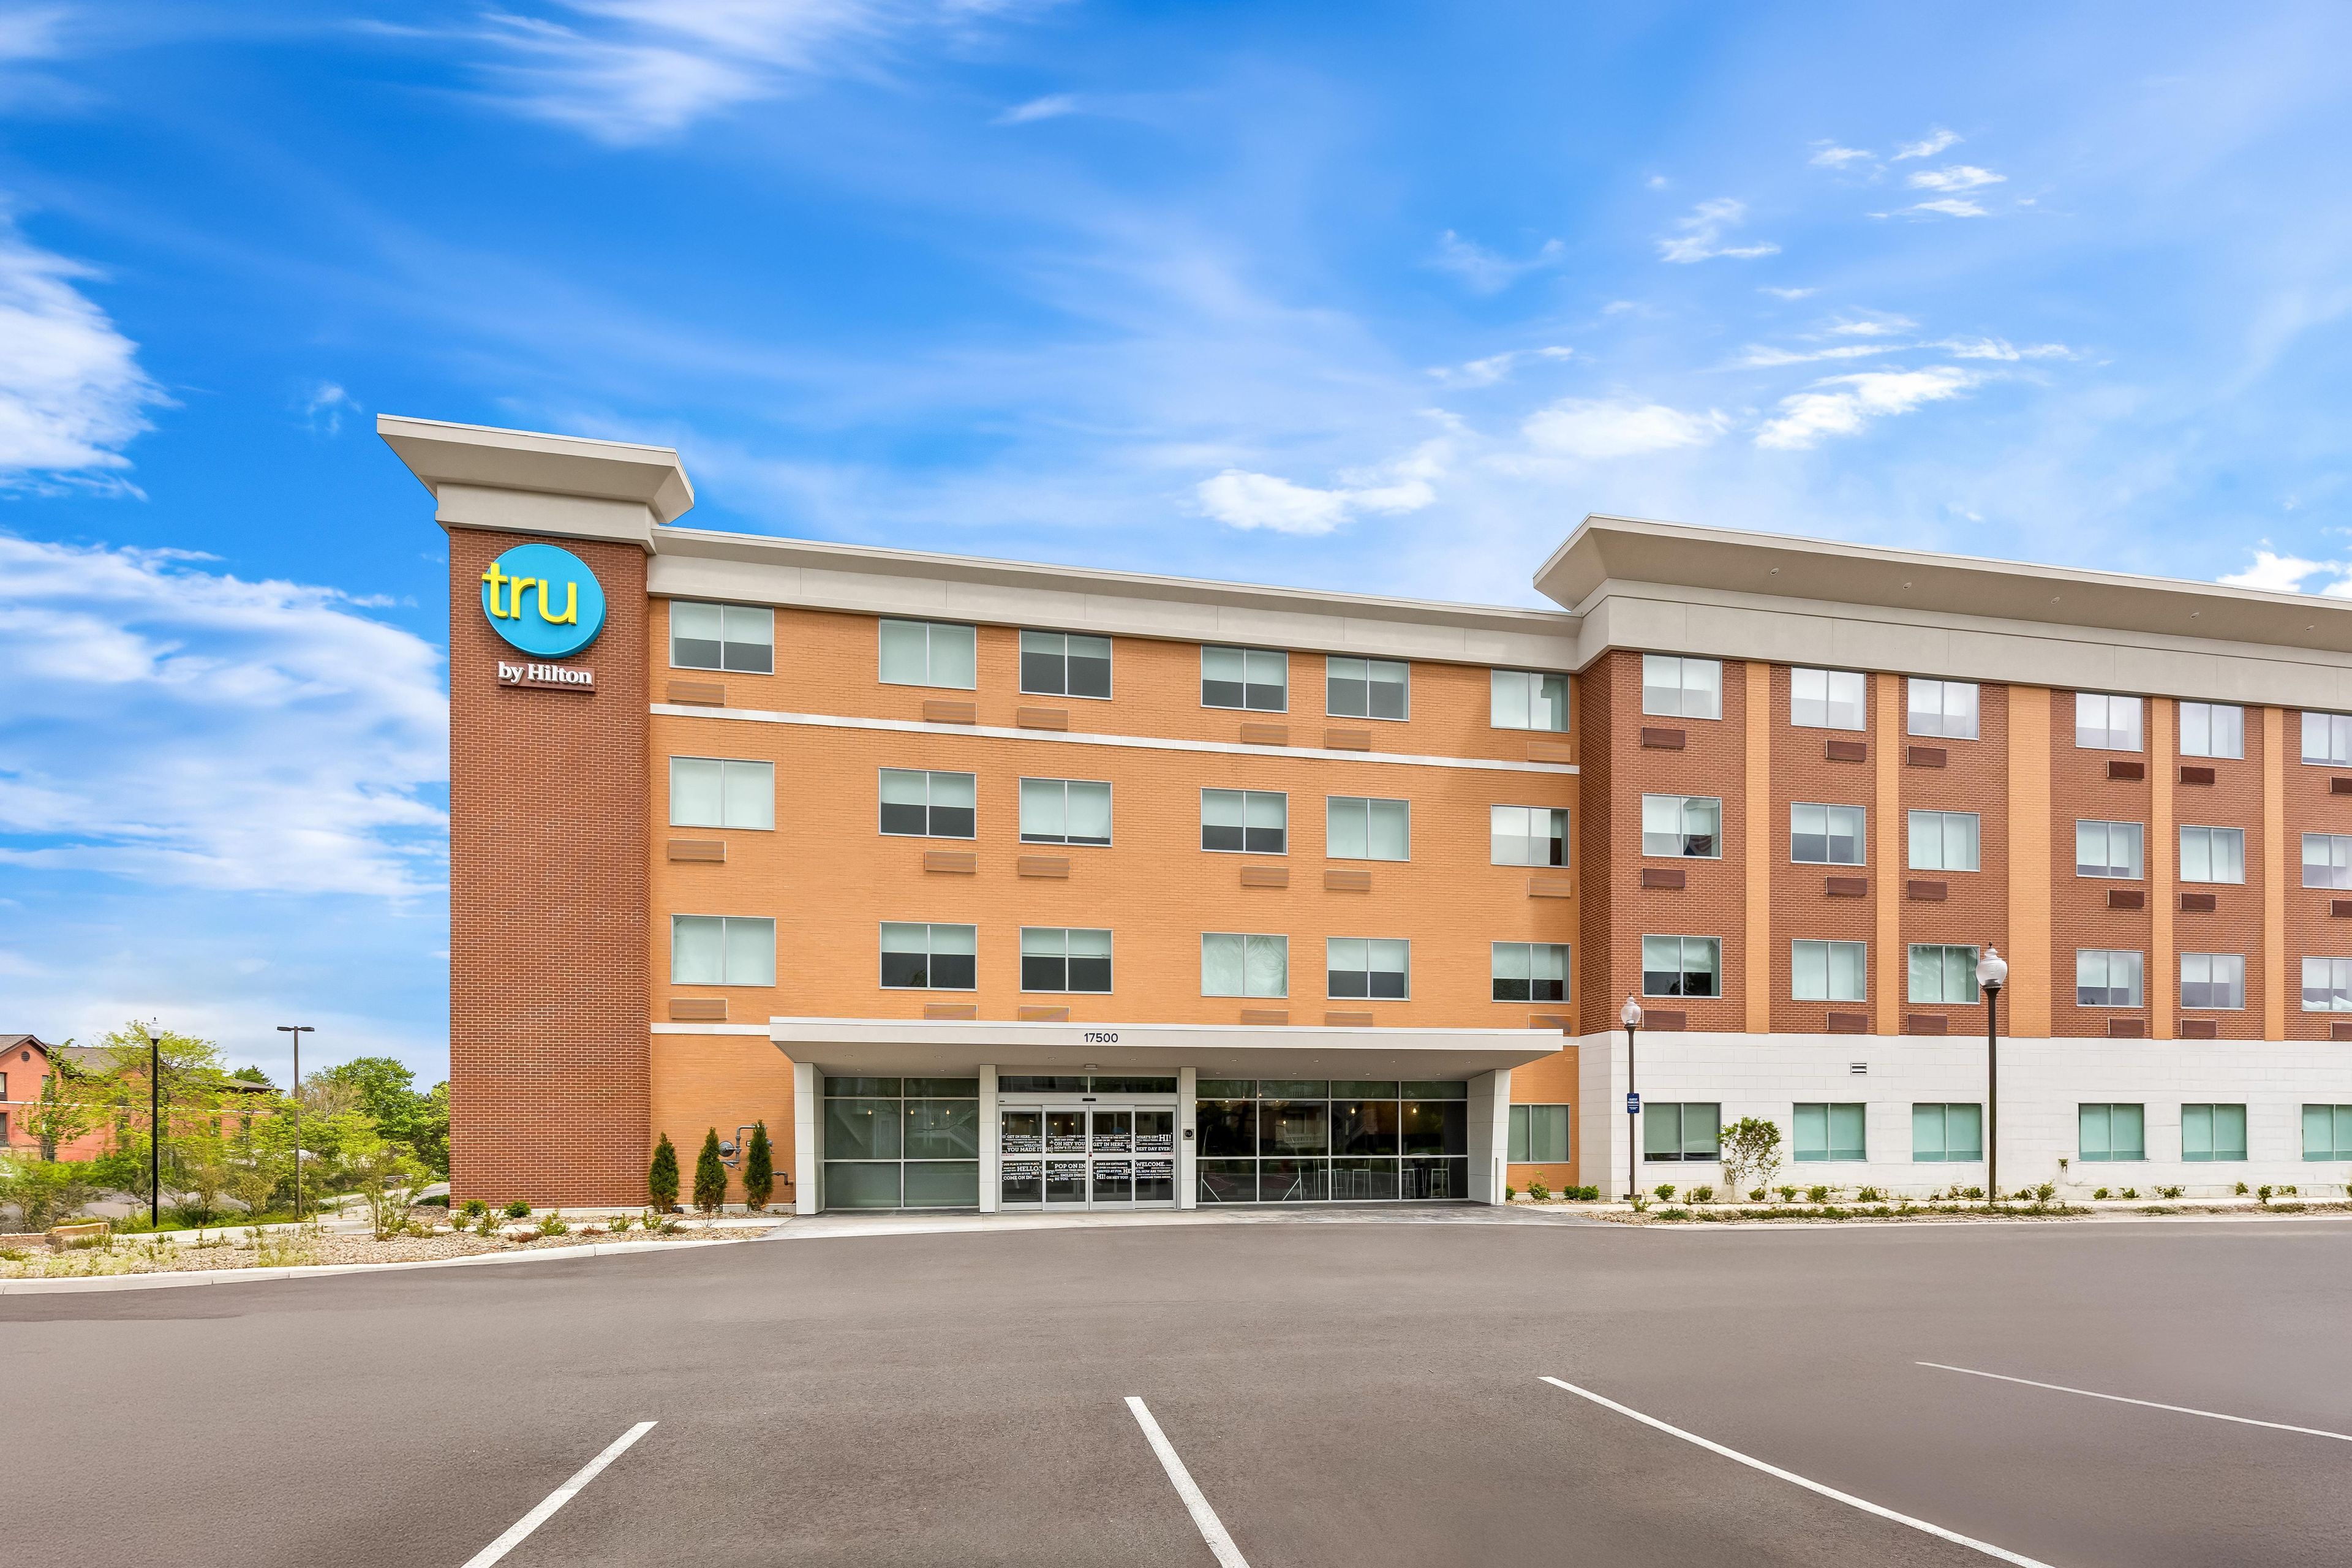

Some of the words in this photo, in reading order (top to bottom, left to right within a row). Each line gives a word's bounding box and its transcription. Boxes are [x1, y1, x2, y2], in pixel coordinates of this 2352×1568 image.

[481, 562, 577, 625] tru
[498, 661, 525, 684] by
[527, 663, 593, 685] Hilton
[1084, 1033, 1118, 1042] 17500
